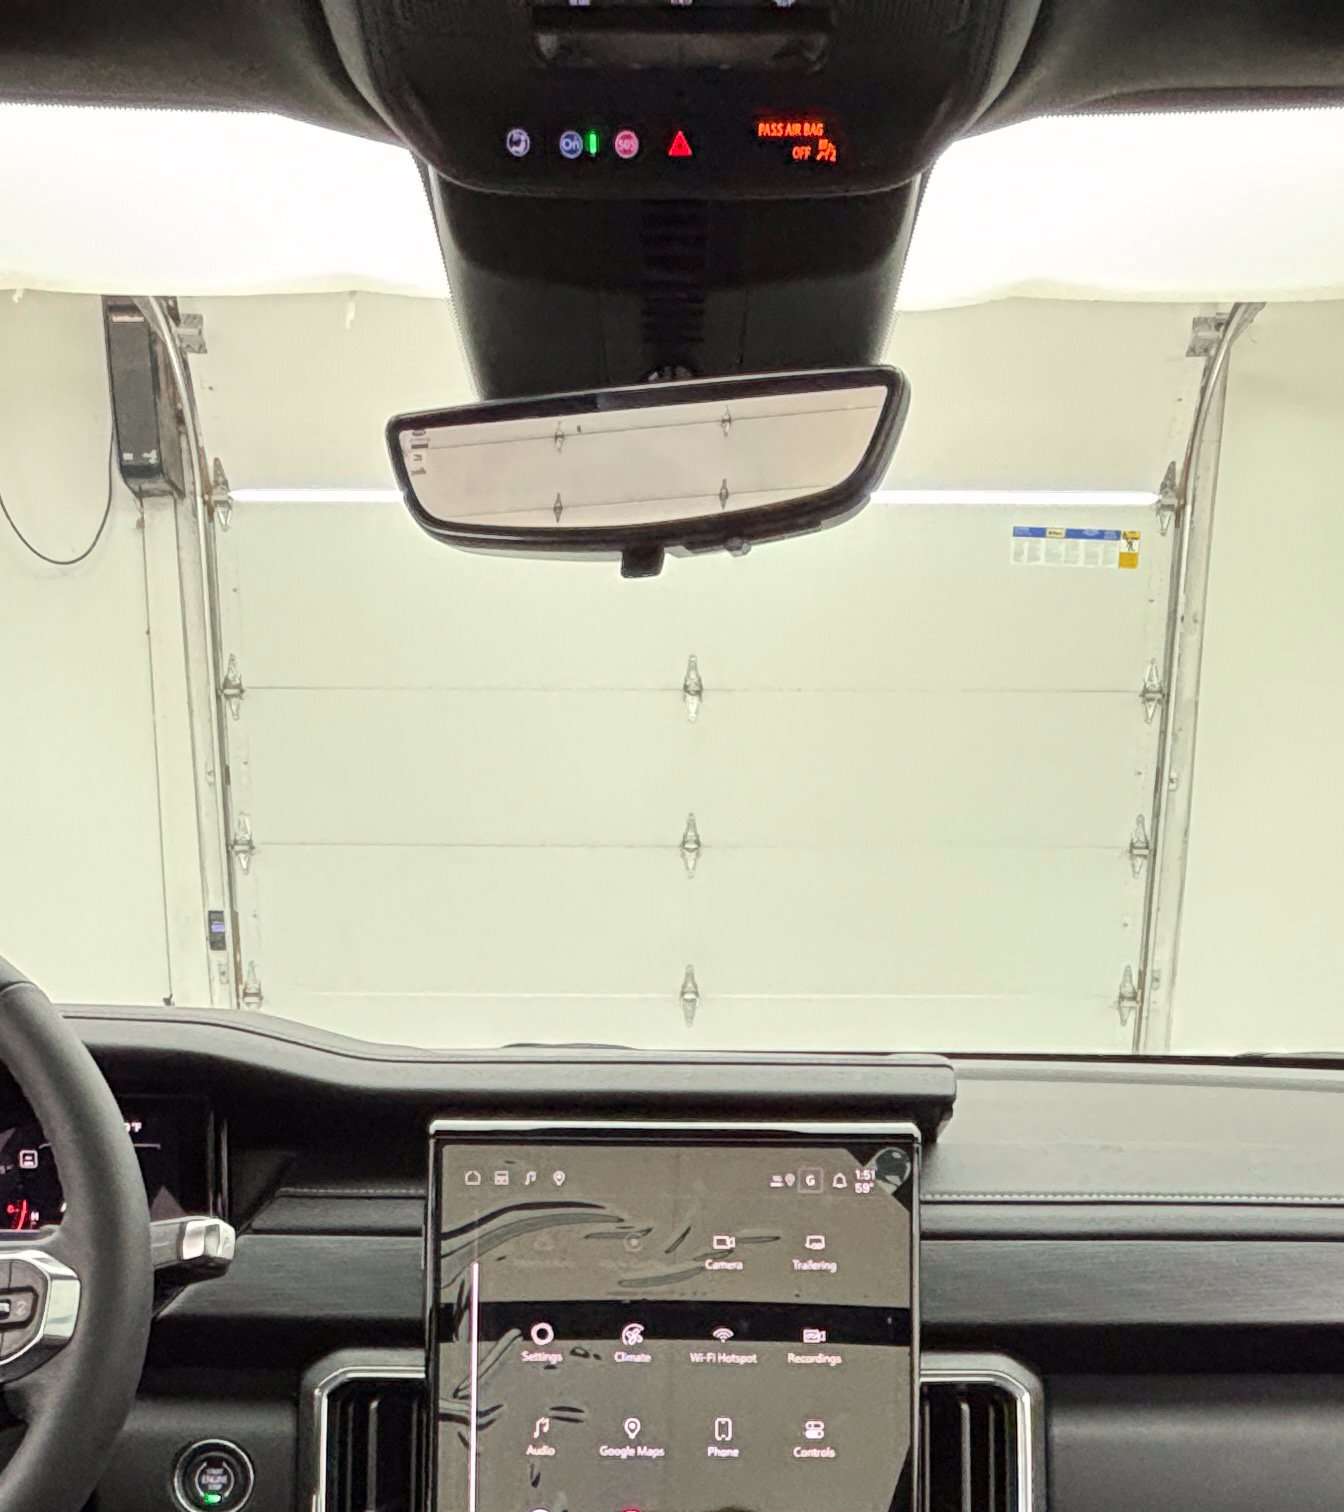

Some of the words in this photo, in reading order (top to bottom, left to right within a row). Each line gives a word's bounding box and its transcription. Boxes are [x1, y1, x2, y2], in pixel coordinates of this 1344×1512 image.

[758, 122, 784, 136] PASS
[785, 122, 802, 136] AIR
[803, 122, 824, 136] BAG
[792, 146, 811, 160] OFF
[855, 1169, 876, 1180] 1:51
[854, 1182, 875, 1193] 59°
[704, 1259, 744, 1270] Camera
[792, 1259, 838, 1273] Trailering
[520, 1350, 563, 1364] Settings
[614, 1351, 652, 1363] Climate
[717, 1352, 758, 1365] Hotspot
[787, 1352, 843, 1366] Recordings
[525, 1444, 556, 1456] Audio
[599, 1445, 636, 1459] Google
[636, 1445, 666, 1459] Maps
[707, 1446, 740, 1458] Phone
[792, 1446, 836, 1458] Controls
